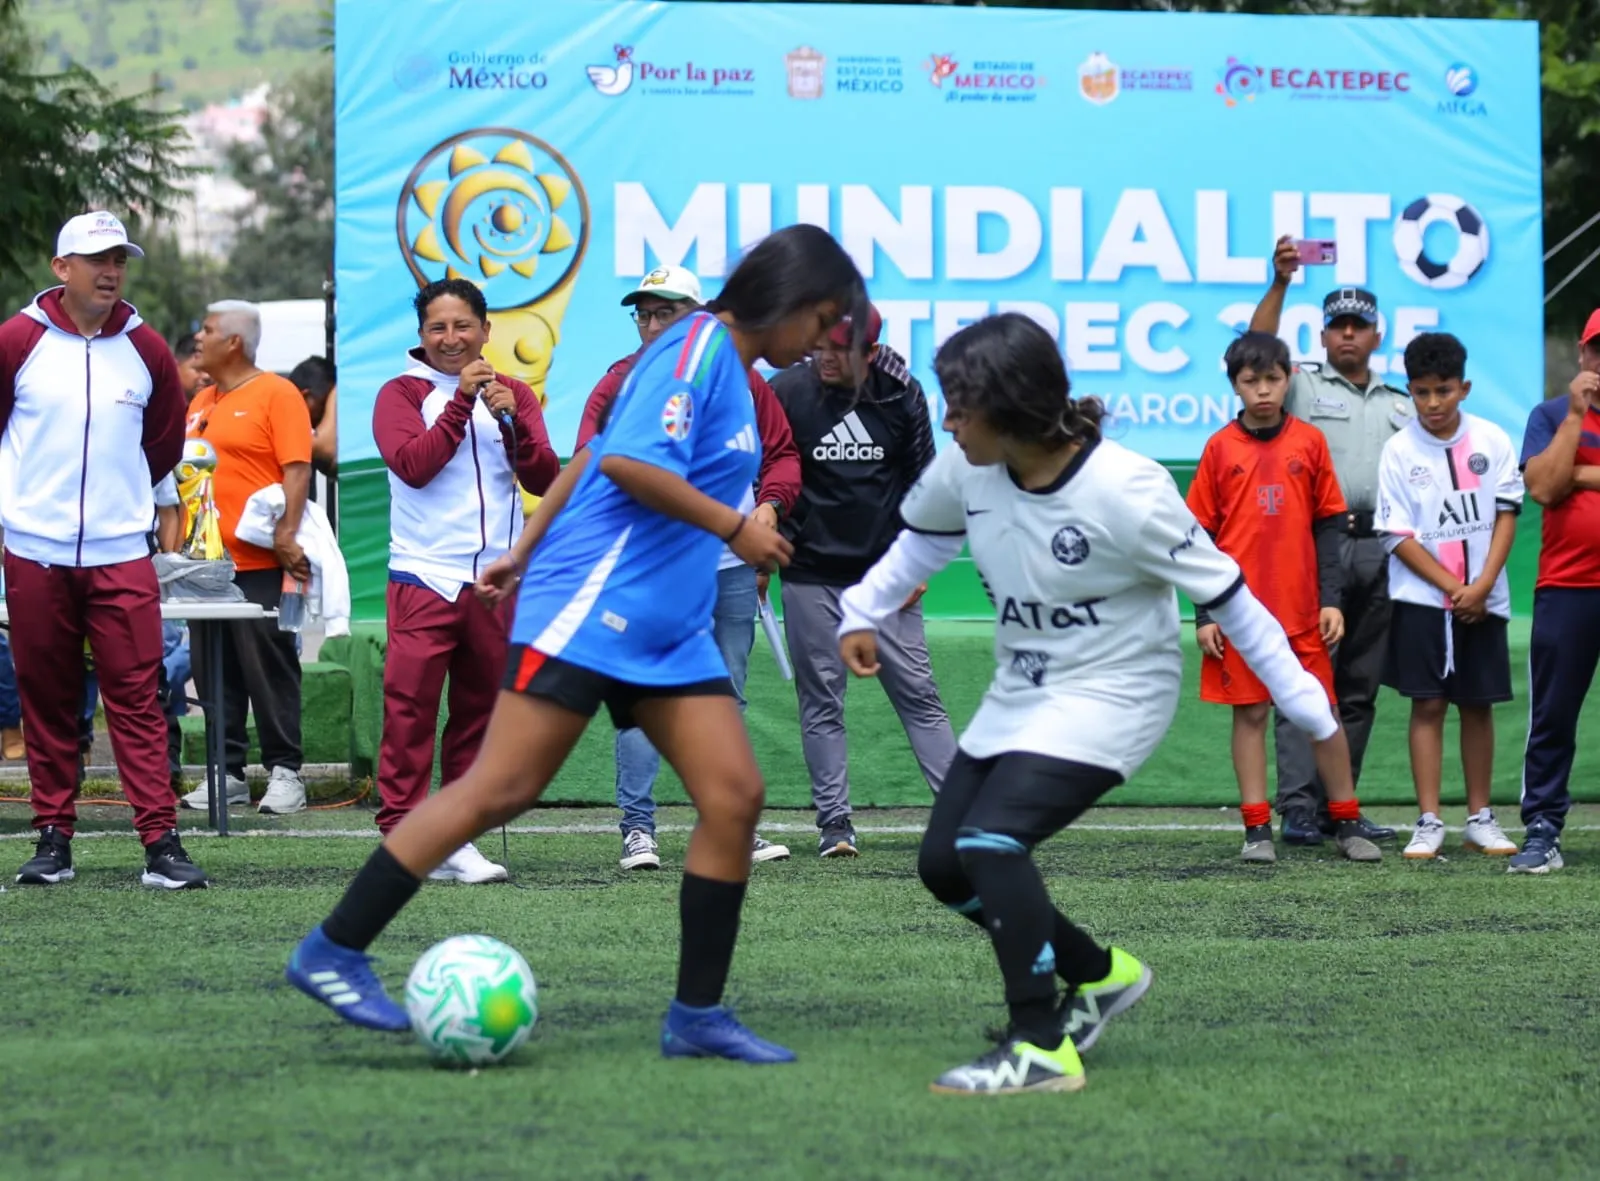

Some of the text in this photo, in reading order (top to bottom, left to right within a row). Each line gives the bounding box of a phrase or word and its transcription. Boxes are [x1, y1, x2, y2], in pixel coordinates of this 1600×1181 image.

[448, 51, 547, 64] Gobierno de
[448, 65, 548, 89] México
[640, 61, 755, 87] Por la paz
[837, 66, 902, 77] ESTADO DE
[1121, 70, 1193, 80] ECATEPEC
[1271, 68, 1411, 92] ECATEPEC
[1437, 101, 1488, 117] MEGA
[812, 442, 885, 460] adidas
